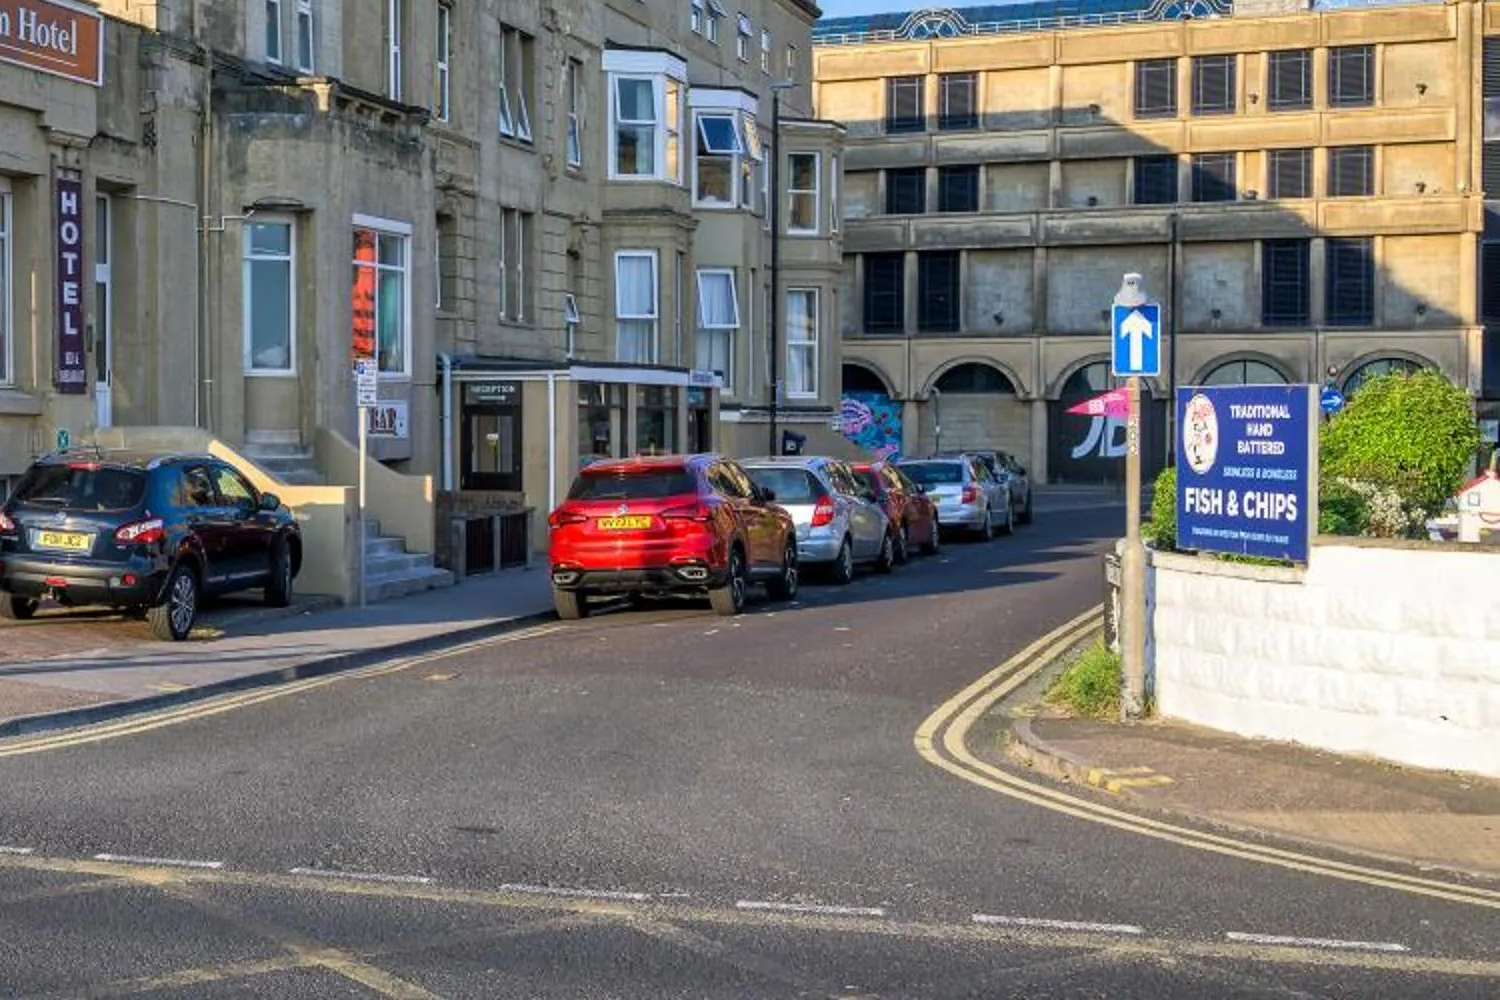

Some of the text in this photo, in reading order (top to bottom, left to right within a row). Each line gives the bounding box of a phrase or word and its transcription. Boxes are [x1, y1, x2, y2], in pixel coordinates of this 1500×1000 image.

[18, 7, 77, 56] Hotel
[60, 191, 79, 335] HOTEL
[369, 407, 398, 436] BAR
[1229, 404, 1291, 419] TRADITIONAL
[1246, 423, 1273, 437] HAND
[1237, 440, 1285, 455] BATTERED
[1185, 487, 1298, 522] FISH & CHIPS
